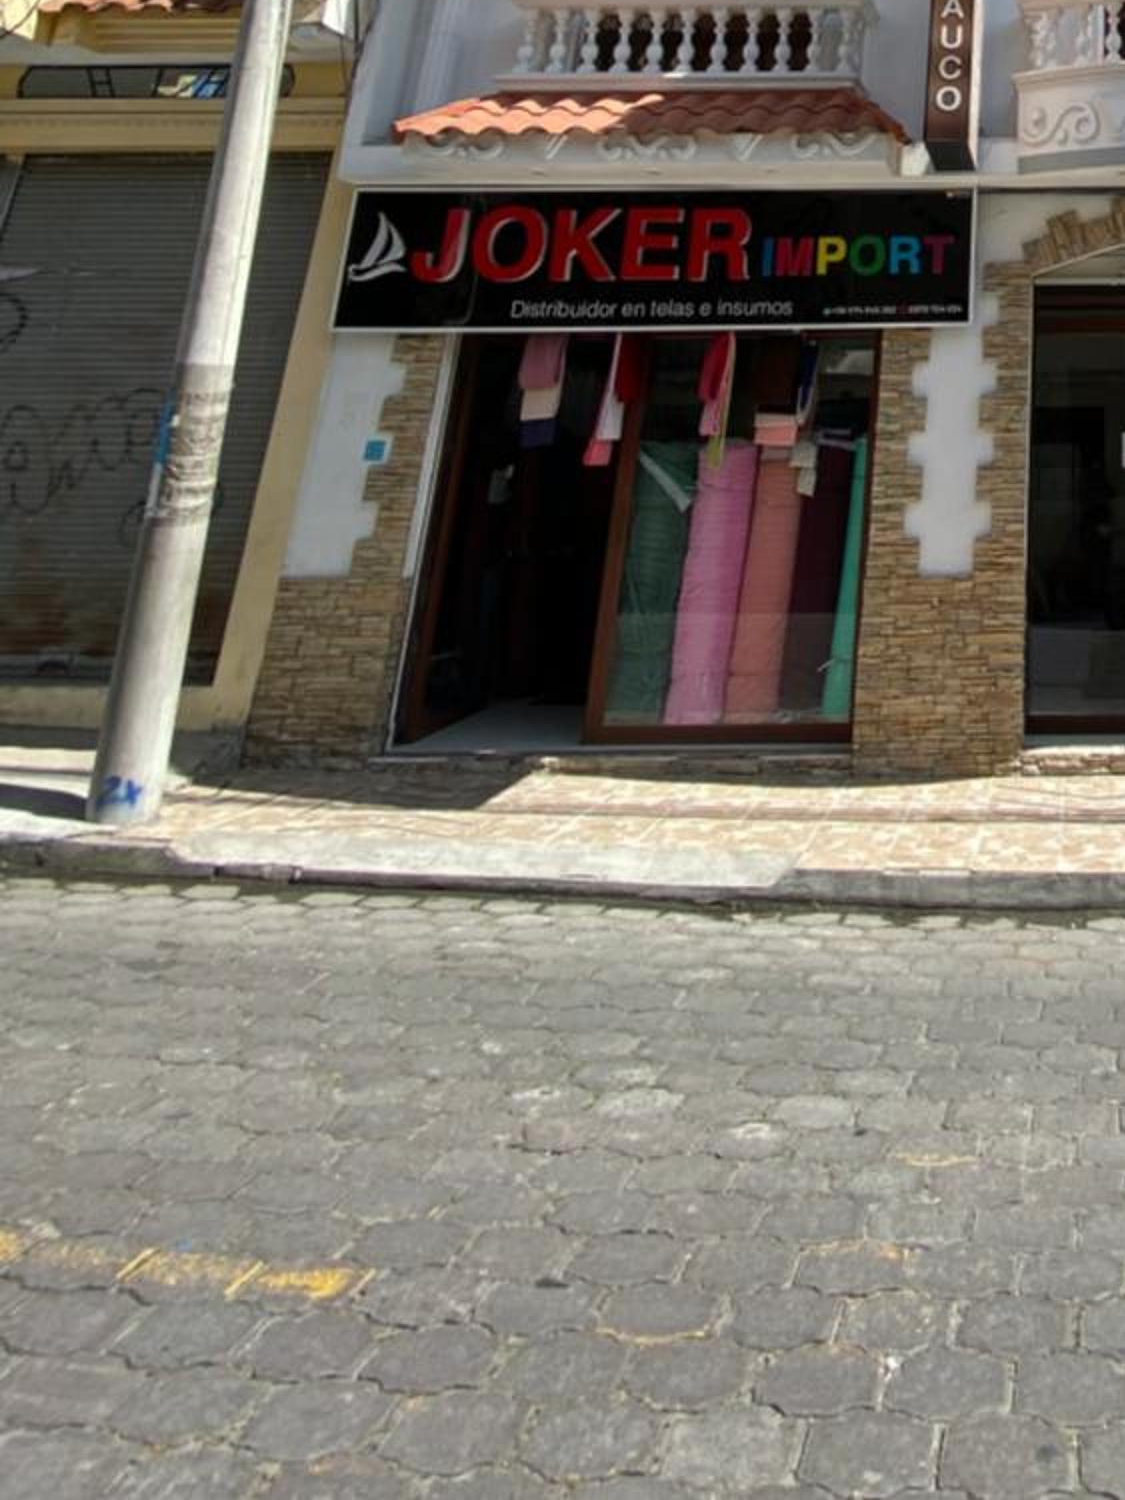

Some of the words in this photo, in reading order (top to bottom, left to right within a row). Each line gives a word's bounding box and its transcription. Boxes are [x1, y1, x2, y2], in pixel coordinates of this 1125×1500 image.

[411, 207, 753, 283] JOKER
[763, 236, 955, 277] IMPORT
[510, 300, 617, 319] Distribuidor
[622, 304, 645, 317] en
[651, 302, 694, 316] telas
[699, 303, 710, 316] e
[717, 300, 793, 316] insumos
